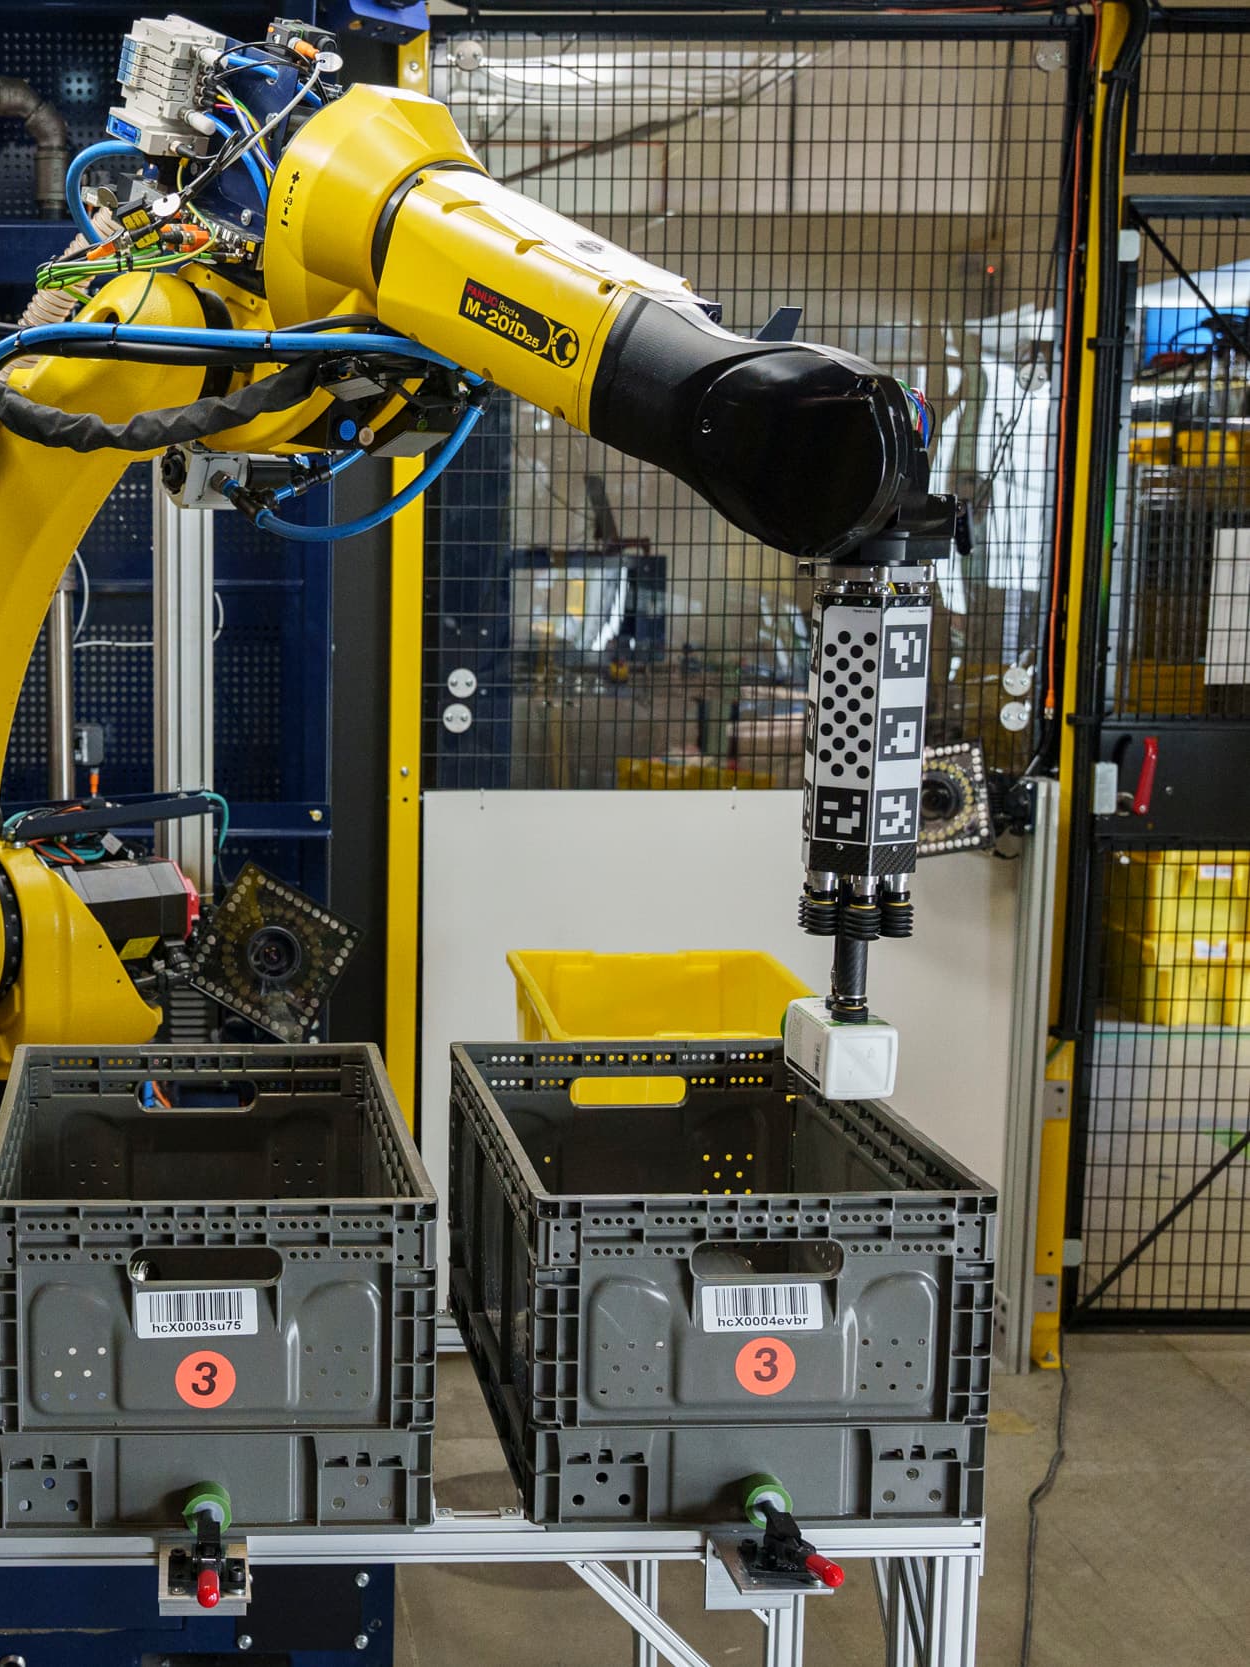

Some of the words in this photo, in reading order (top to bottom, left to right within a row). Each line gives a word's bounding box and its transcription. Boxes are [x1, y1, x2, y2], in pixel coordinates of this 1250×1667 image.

[466, 284, 499, 308] FANUC
[152, 1320, 242, 1333] hcX0003su75
[717, 1315, 809, 1327] hcX0004evbr
[753, 1347, 778, 1382] 3
[191, 1361, 218, 1396] 3
